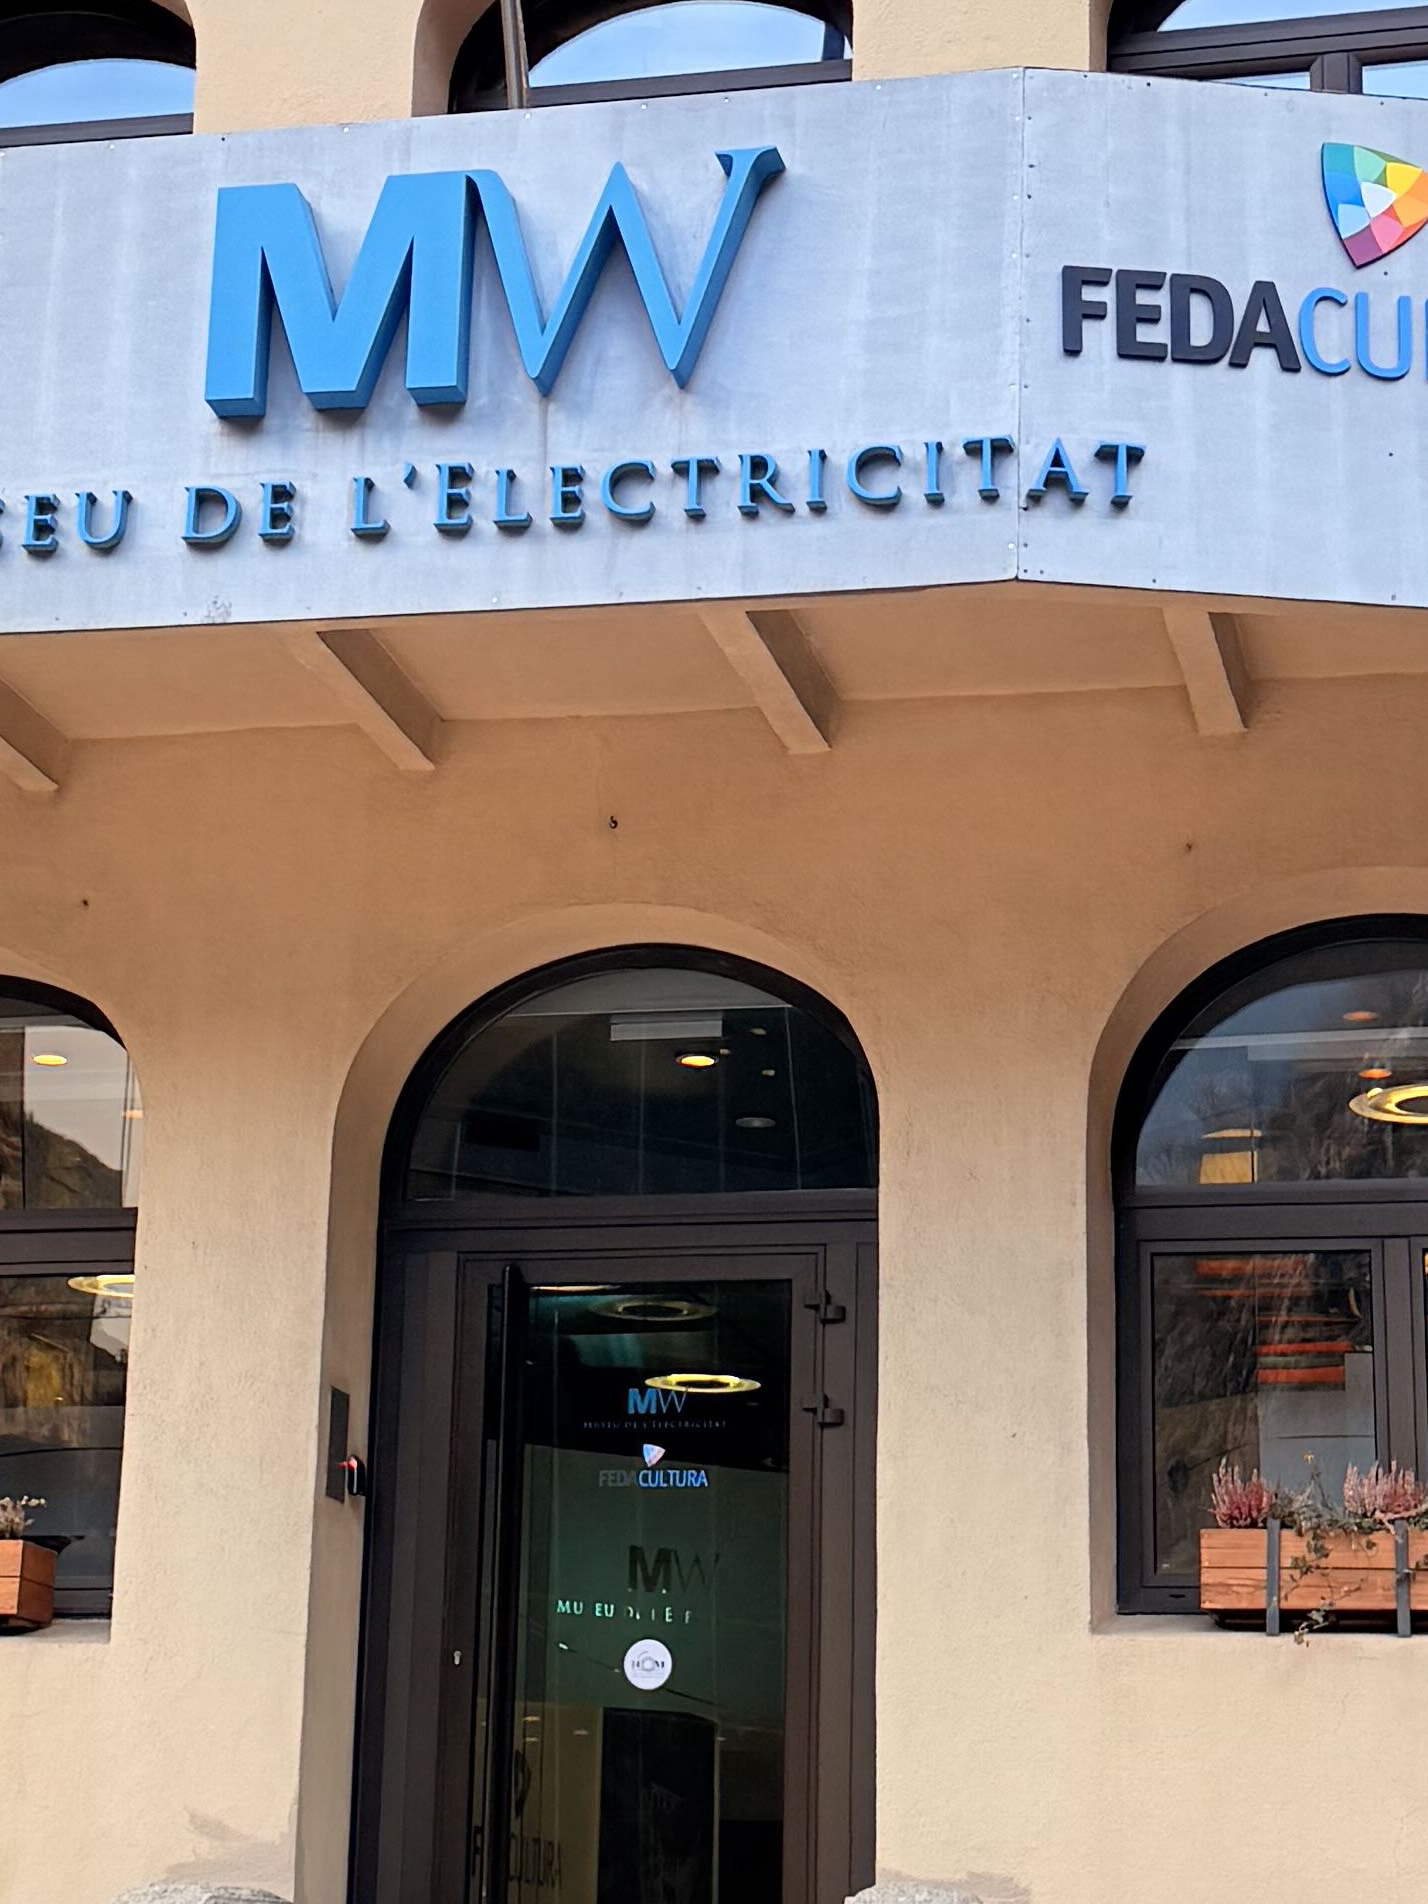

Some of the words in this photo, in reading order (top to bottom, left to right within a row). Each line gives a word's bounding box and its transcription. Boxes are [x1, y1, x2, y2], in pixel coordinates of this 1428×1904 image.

[204, 144, 785, 418] MW
[180, 480, 296, 547] DE
[350, 434, 1147, 539] L'ELECTRICITAT
[628, 1386, 689, 1415] MW
